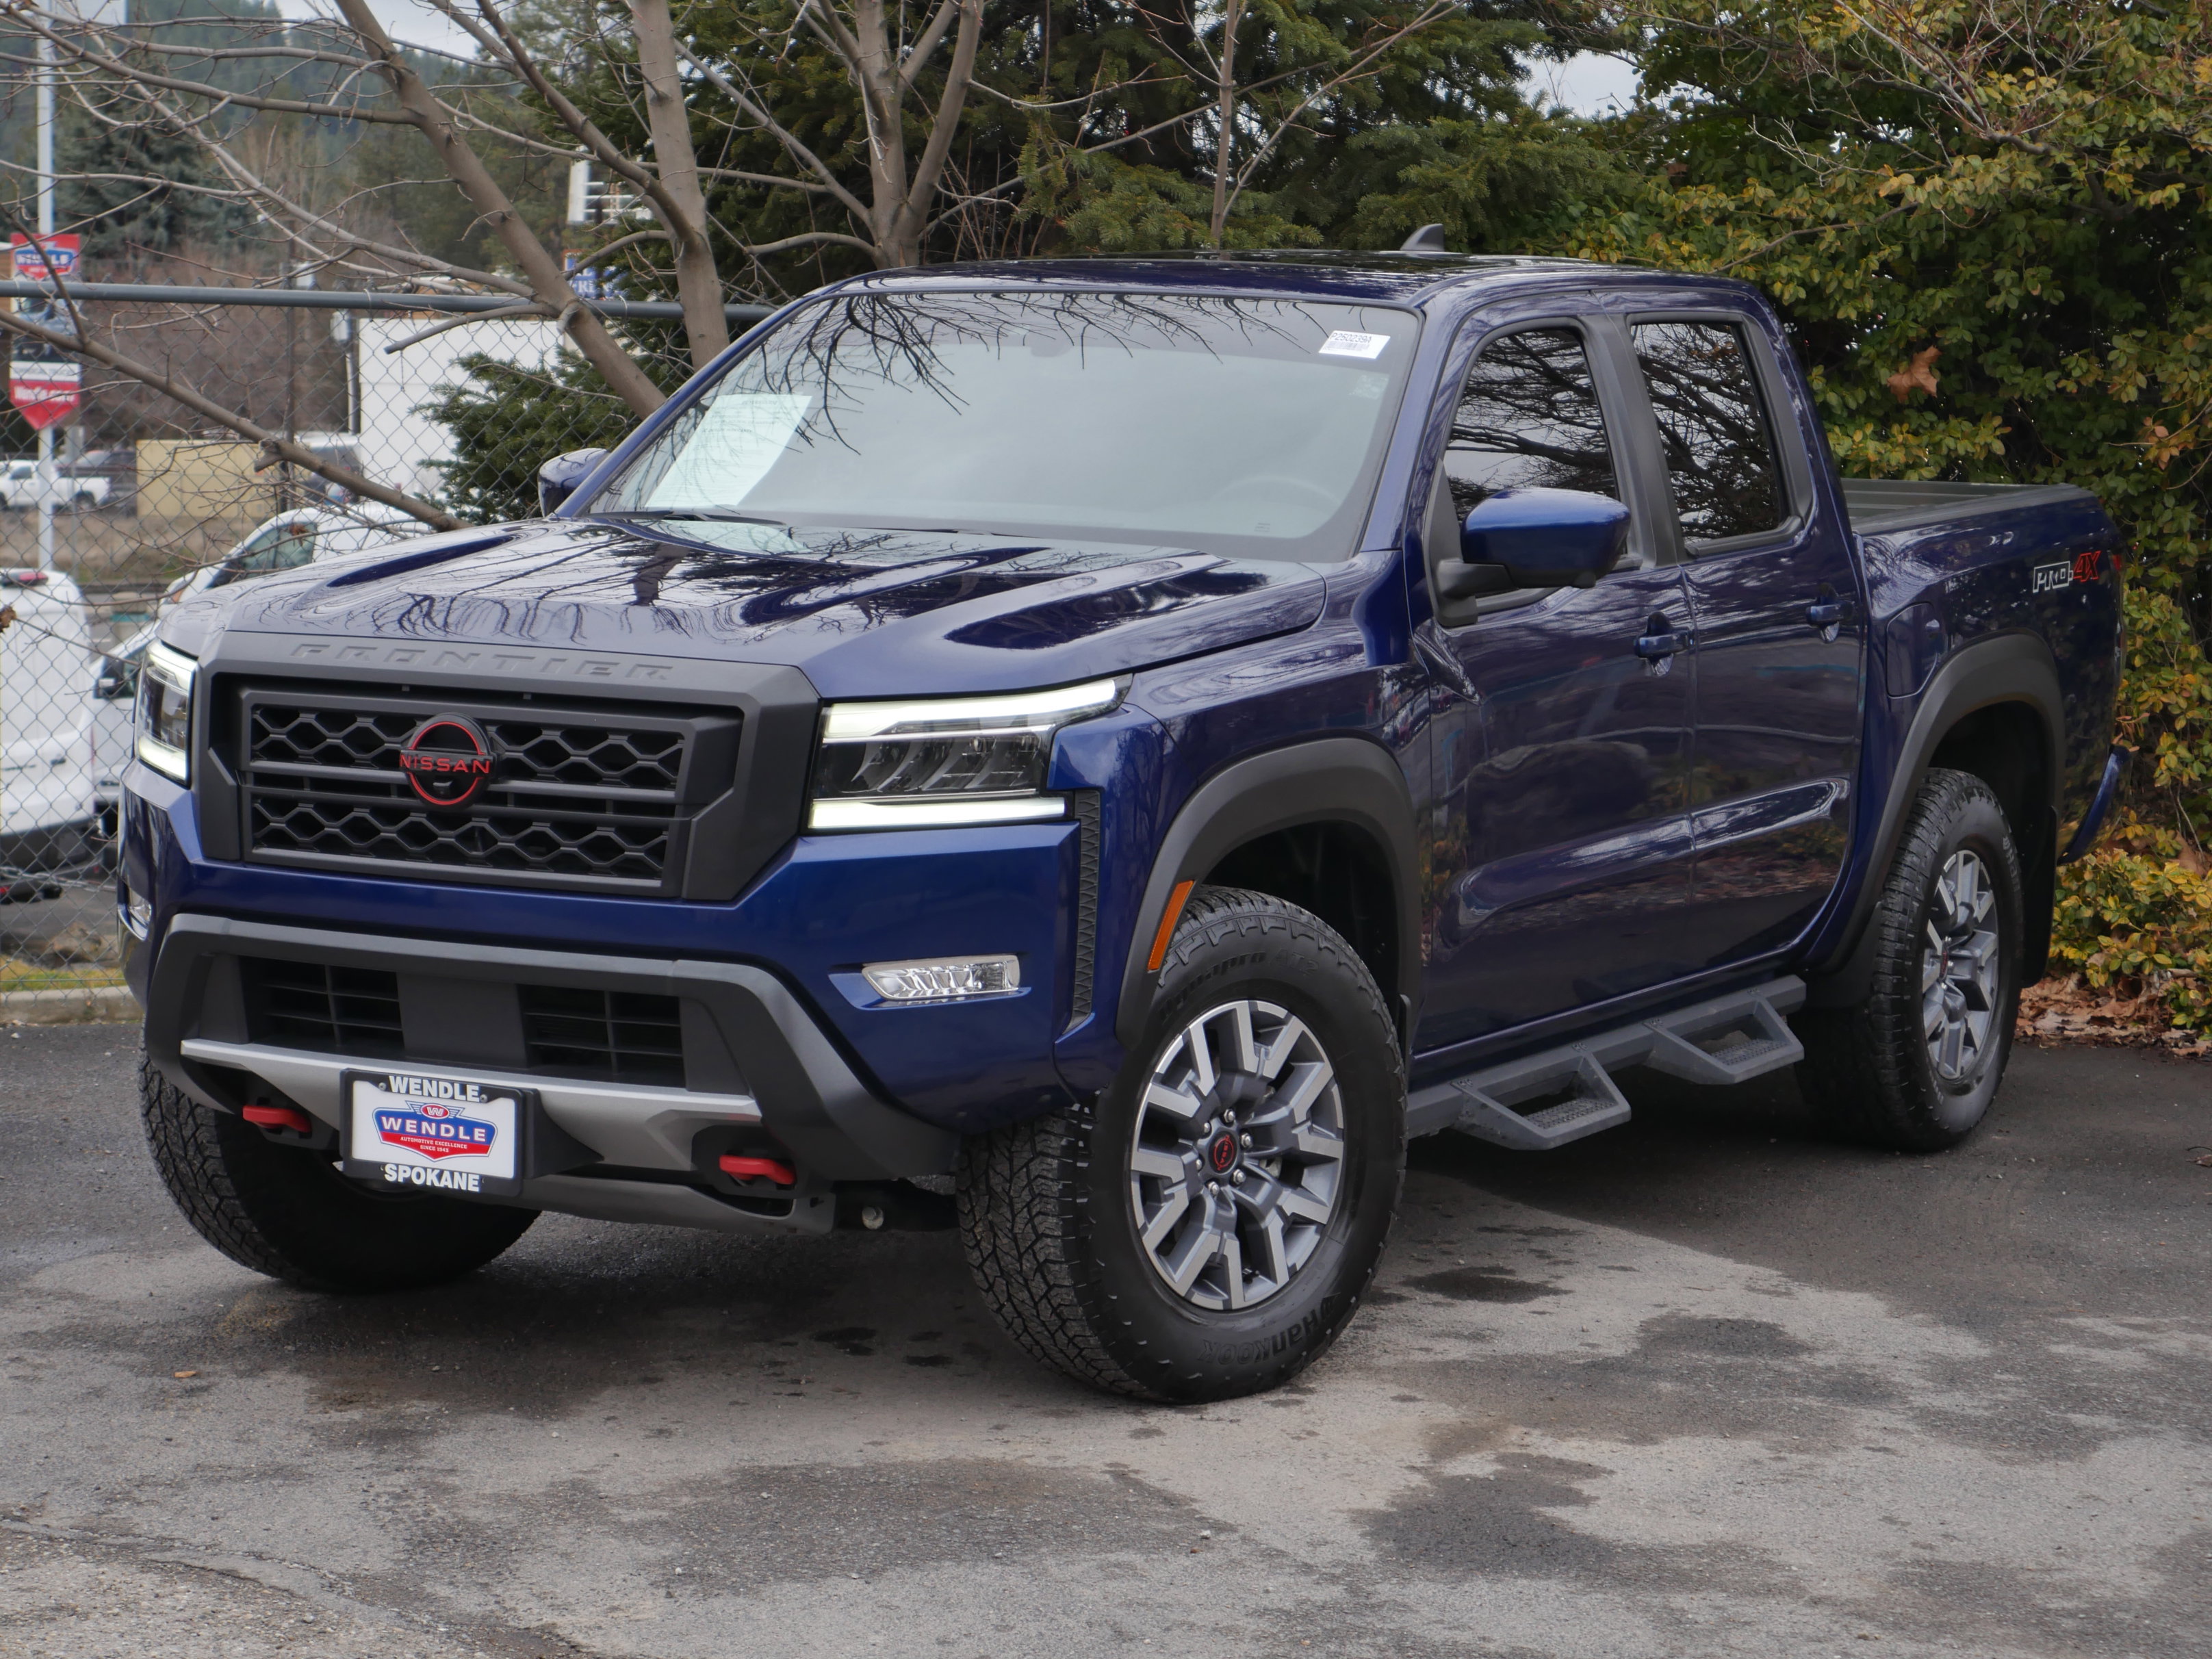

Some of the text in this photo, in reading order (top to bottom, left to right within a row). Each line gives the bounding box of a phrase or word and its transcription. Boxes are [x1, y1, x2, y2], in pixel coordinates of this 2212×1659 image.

[288, 643, 674, 681] FRONTIER
[400, 754, 491, 774] NISSAN
[389, 1075, 480, 1102] WENDLE
[381, 1116, 486, 1142] WENDLE
[400, 1136, 467, 1150] AUTOMOTIVE EXCELLENCE
[384, 1163, 480, 1192] SPOKANE
